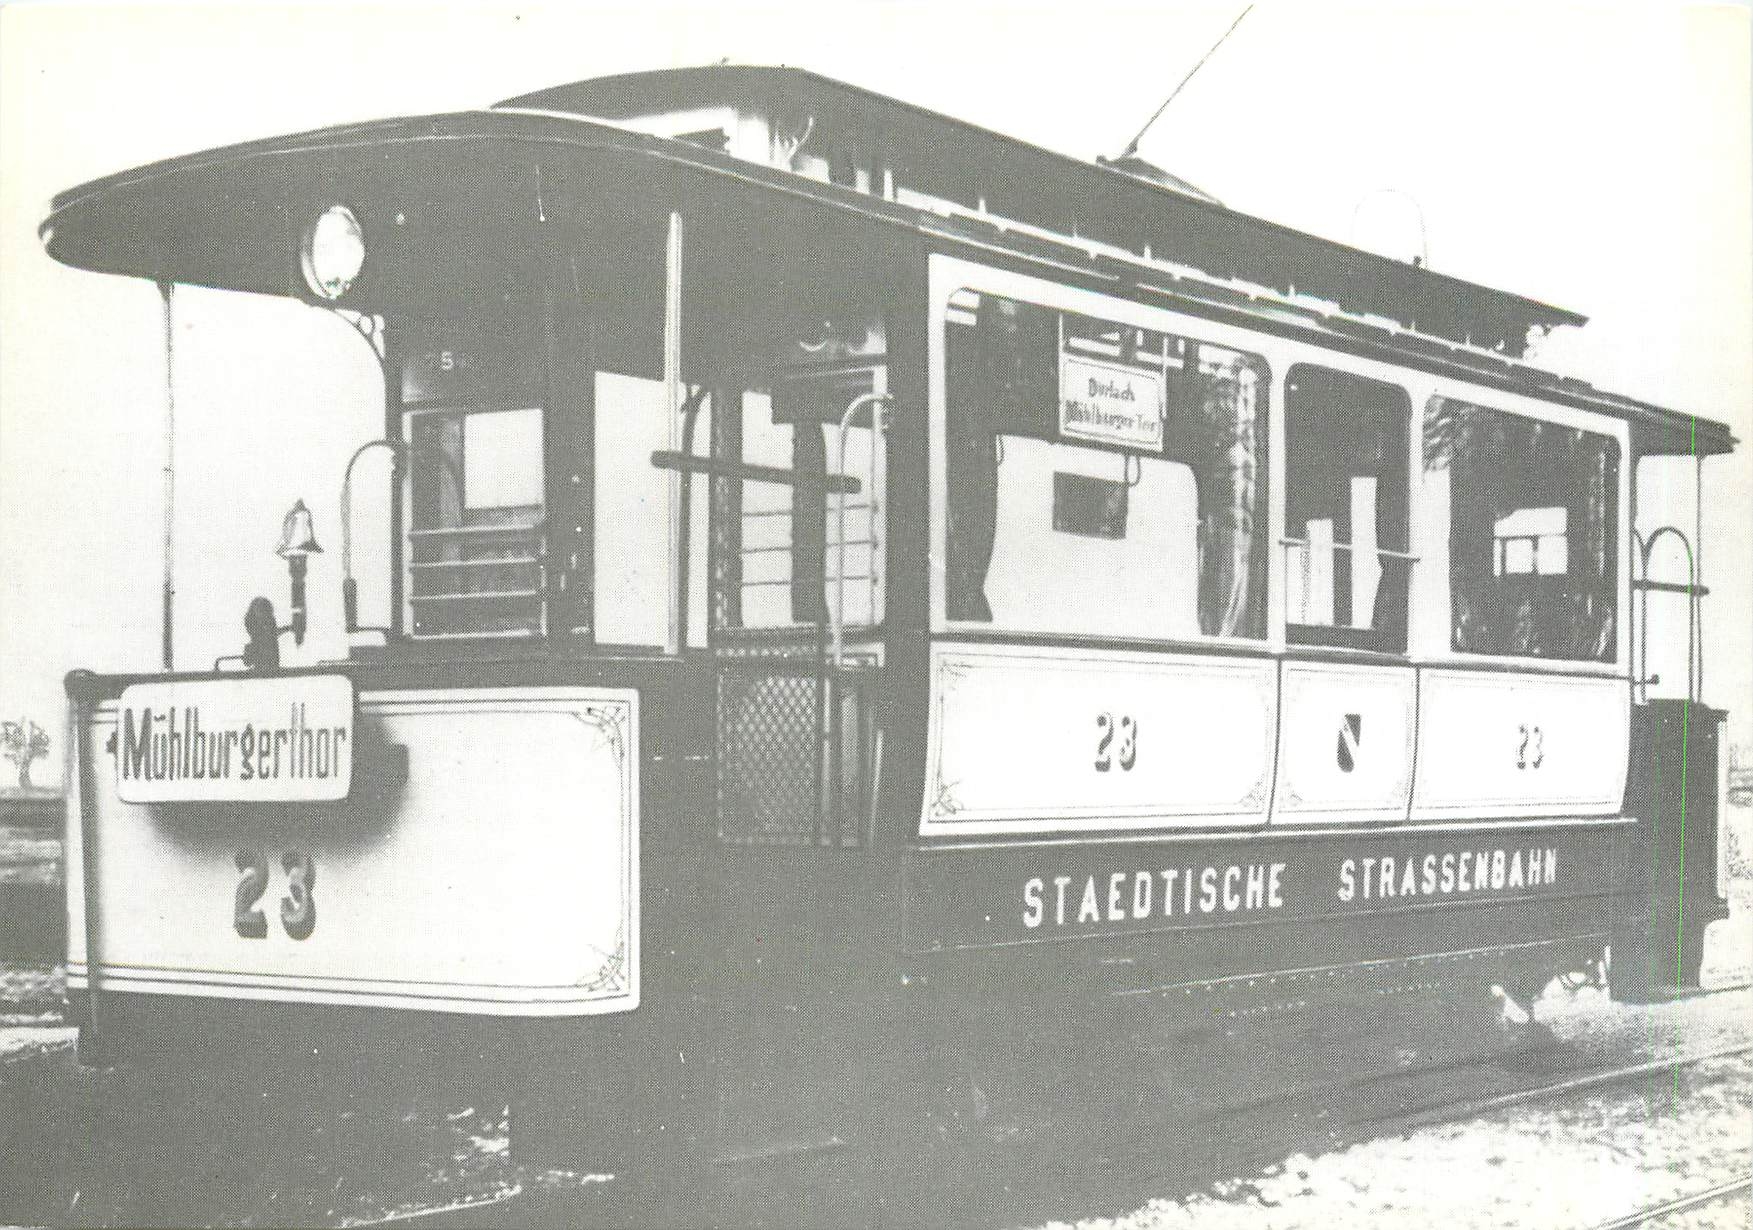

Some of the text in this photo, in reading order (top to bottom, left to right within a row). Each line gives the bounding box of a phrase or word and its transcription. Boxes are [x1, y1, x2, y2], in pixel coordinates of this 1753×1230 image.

[1087, 376, 1136, 402] Durlach
[123, 702, 347, 781] Mühlburgerthor
[1094, 711, 1137, 772] 23
[1515, 723, 1545, 770] 23
[233, 847, 317, 941] 23
[1022, 862, 1287, 928] STAEDTISCHE
[1337, 847, 1557, 901] STRASSENBAHN
